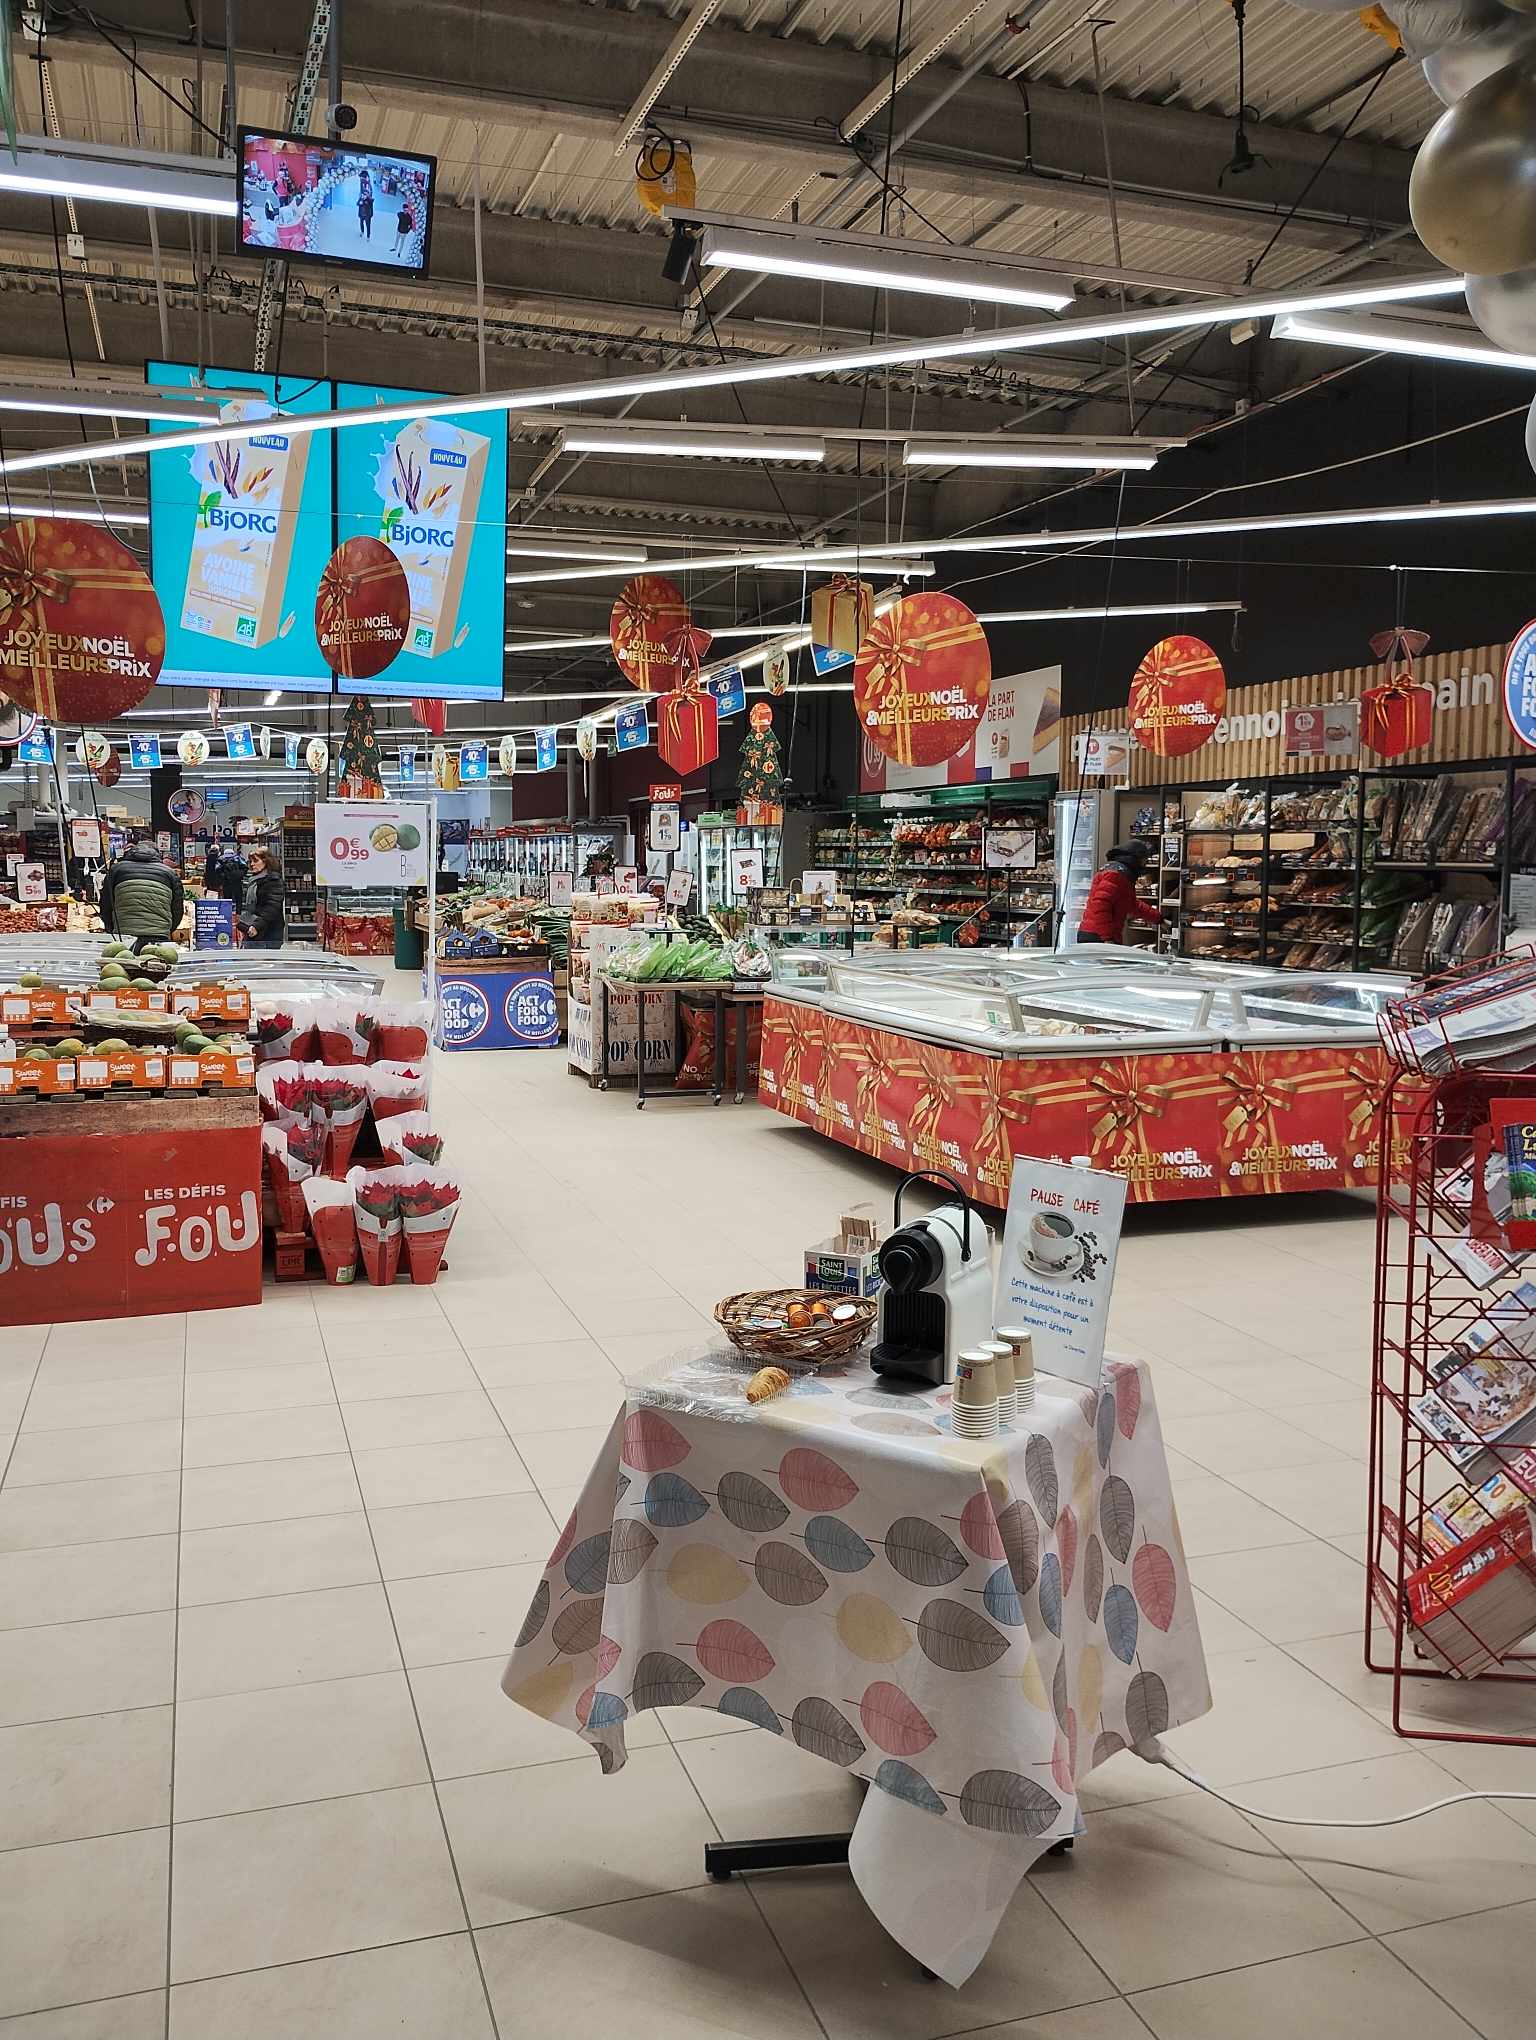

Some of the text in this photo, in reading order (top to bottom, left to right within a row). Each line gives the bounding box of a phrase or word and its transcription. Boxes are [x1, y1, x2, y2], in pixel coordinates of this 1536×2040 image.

[433, 452, 463, 465] NOUVEAU
[364, 612, 393, 628] NOËL
[3, 629, 135, 658] JOYEUX NOËL
[879, 685, 968, 710] JOYEUX NOËL
[988, 690, 1015, 708] LA PART
[988, 705, 1015, 722] DE FLAN
[1177, 700, 1208, 714] NOËL
[517, 995, 540, 1007] ACT
[610, 994, 631, 1006] POP
[444, 1009, 461, 1019] OR
[517, 1006, 539, 1016] FOR
[444, 1018, 469, 1029] OOD
[517, 1015, 547, 1026] FOOD
[882, 1119, 901, 1136] NOËL
[941, 1140, 962, 1159] NOËL
[1161, 1147, 1201, 1166] NOËL
[1242, 1140, 1328, 1162] JOYEUX NOËL
[144, 1183, 227, 1201] LES DÉFIS
[0, 1195, 29, 1210] FIS
[1030, 1188, 1100, 1216] PAUSE CAFÉ
[821, 1259, 843, 1269] SAINT
[821, 1266, 843, 1277] LOUIS
[1011, 1277, 1028, 1289] Cette
[1029, 1284, 1055, 1297] machine
[1062, 1291, 1076, 1302] café
[1077, 1297, 1089, 1306] est
[1011, 1296, 1028, 1307] votre
[1029, 1299, 1062, 1315] disposition
[1063, 1310, 1079, 1320] pour
[1023, 1315, 1073, 1335] moment détente
